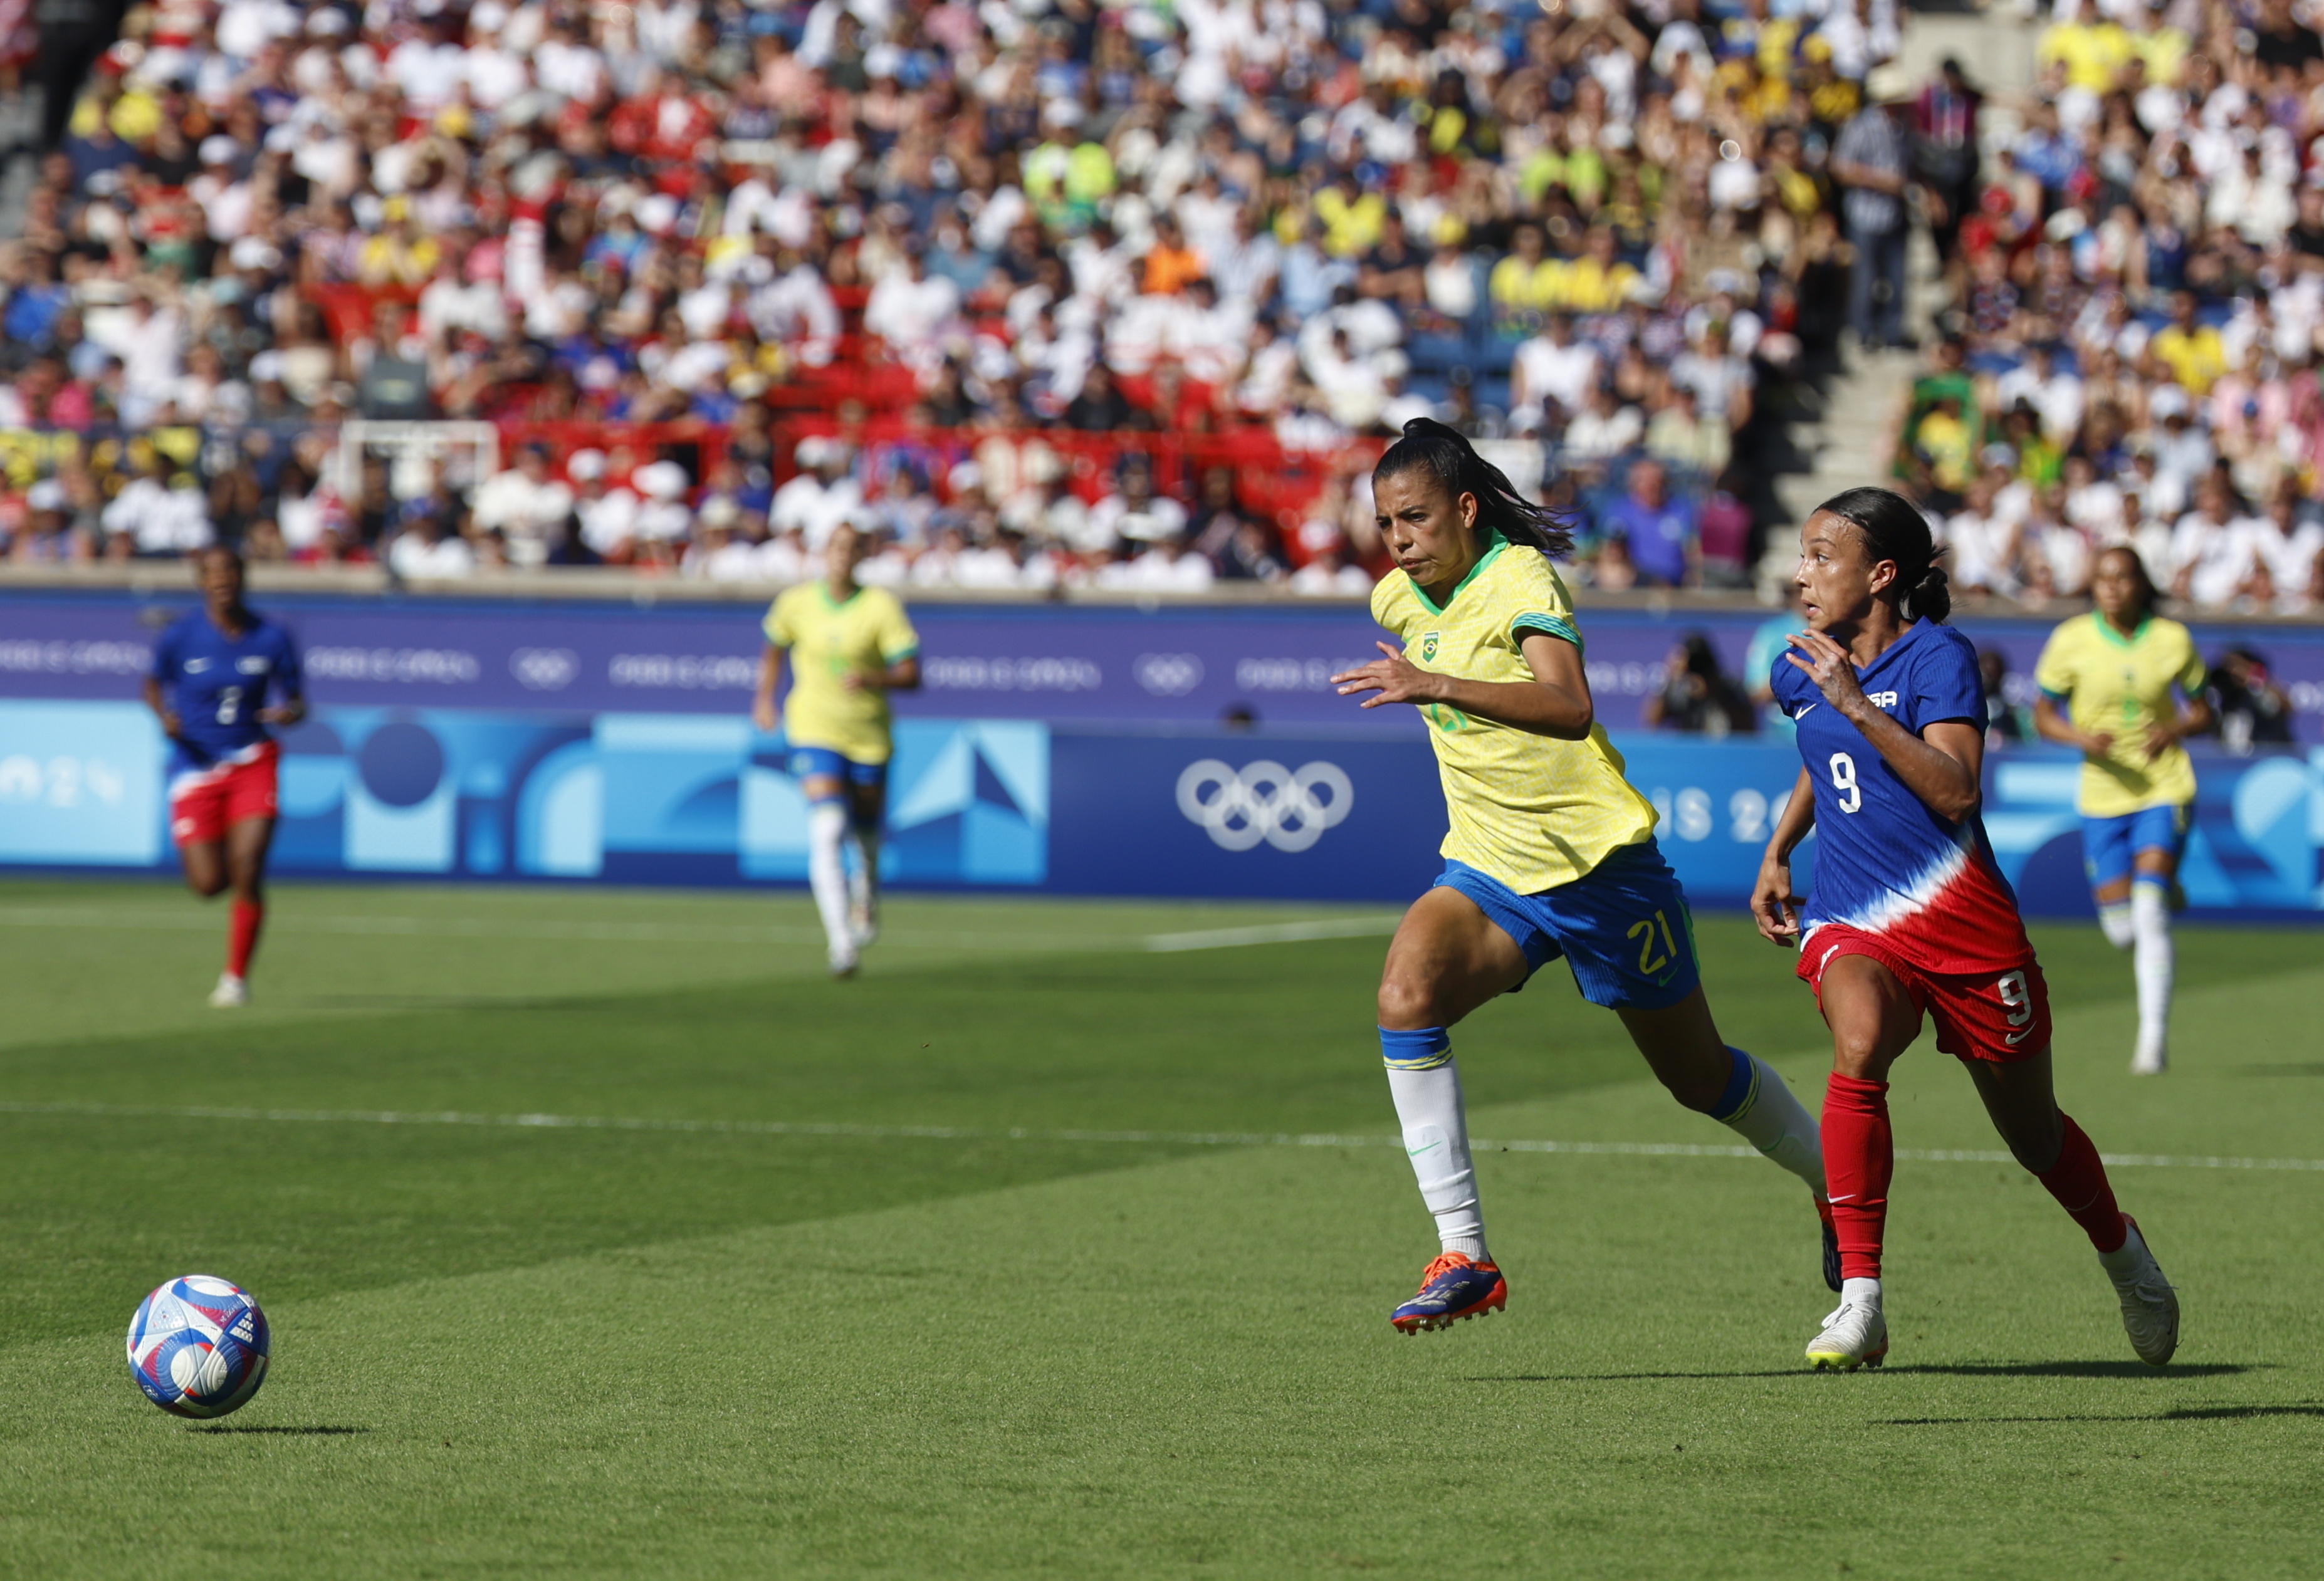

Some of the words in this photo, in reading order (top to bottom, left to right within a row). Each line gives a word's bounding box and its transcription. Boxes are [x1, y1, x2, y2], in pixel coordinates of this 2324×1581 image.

[1866, 691, 1898, 707] SA
[1829, 752, 1861, 814] 9
[1651, 786, 1713, 842] IS
[1627, 909, 1677, 975] 21
[1997, 970, 2032, 1026] 9
